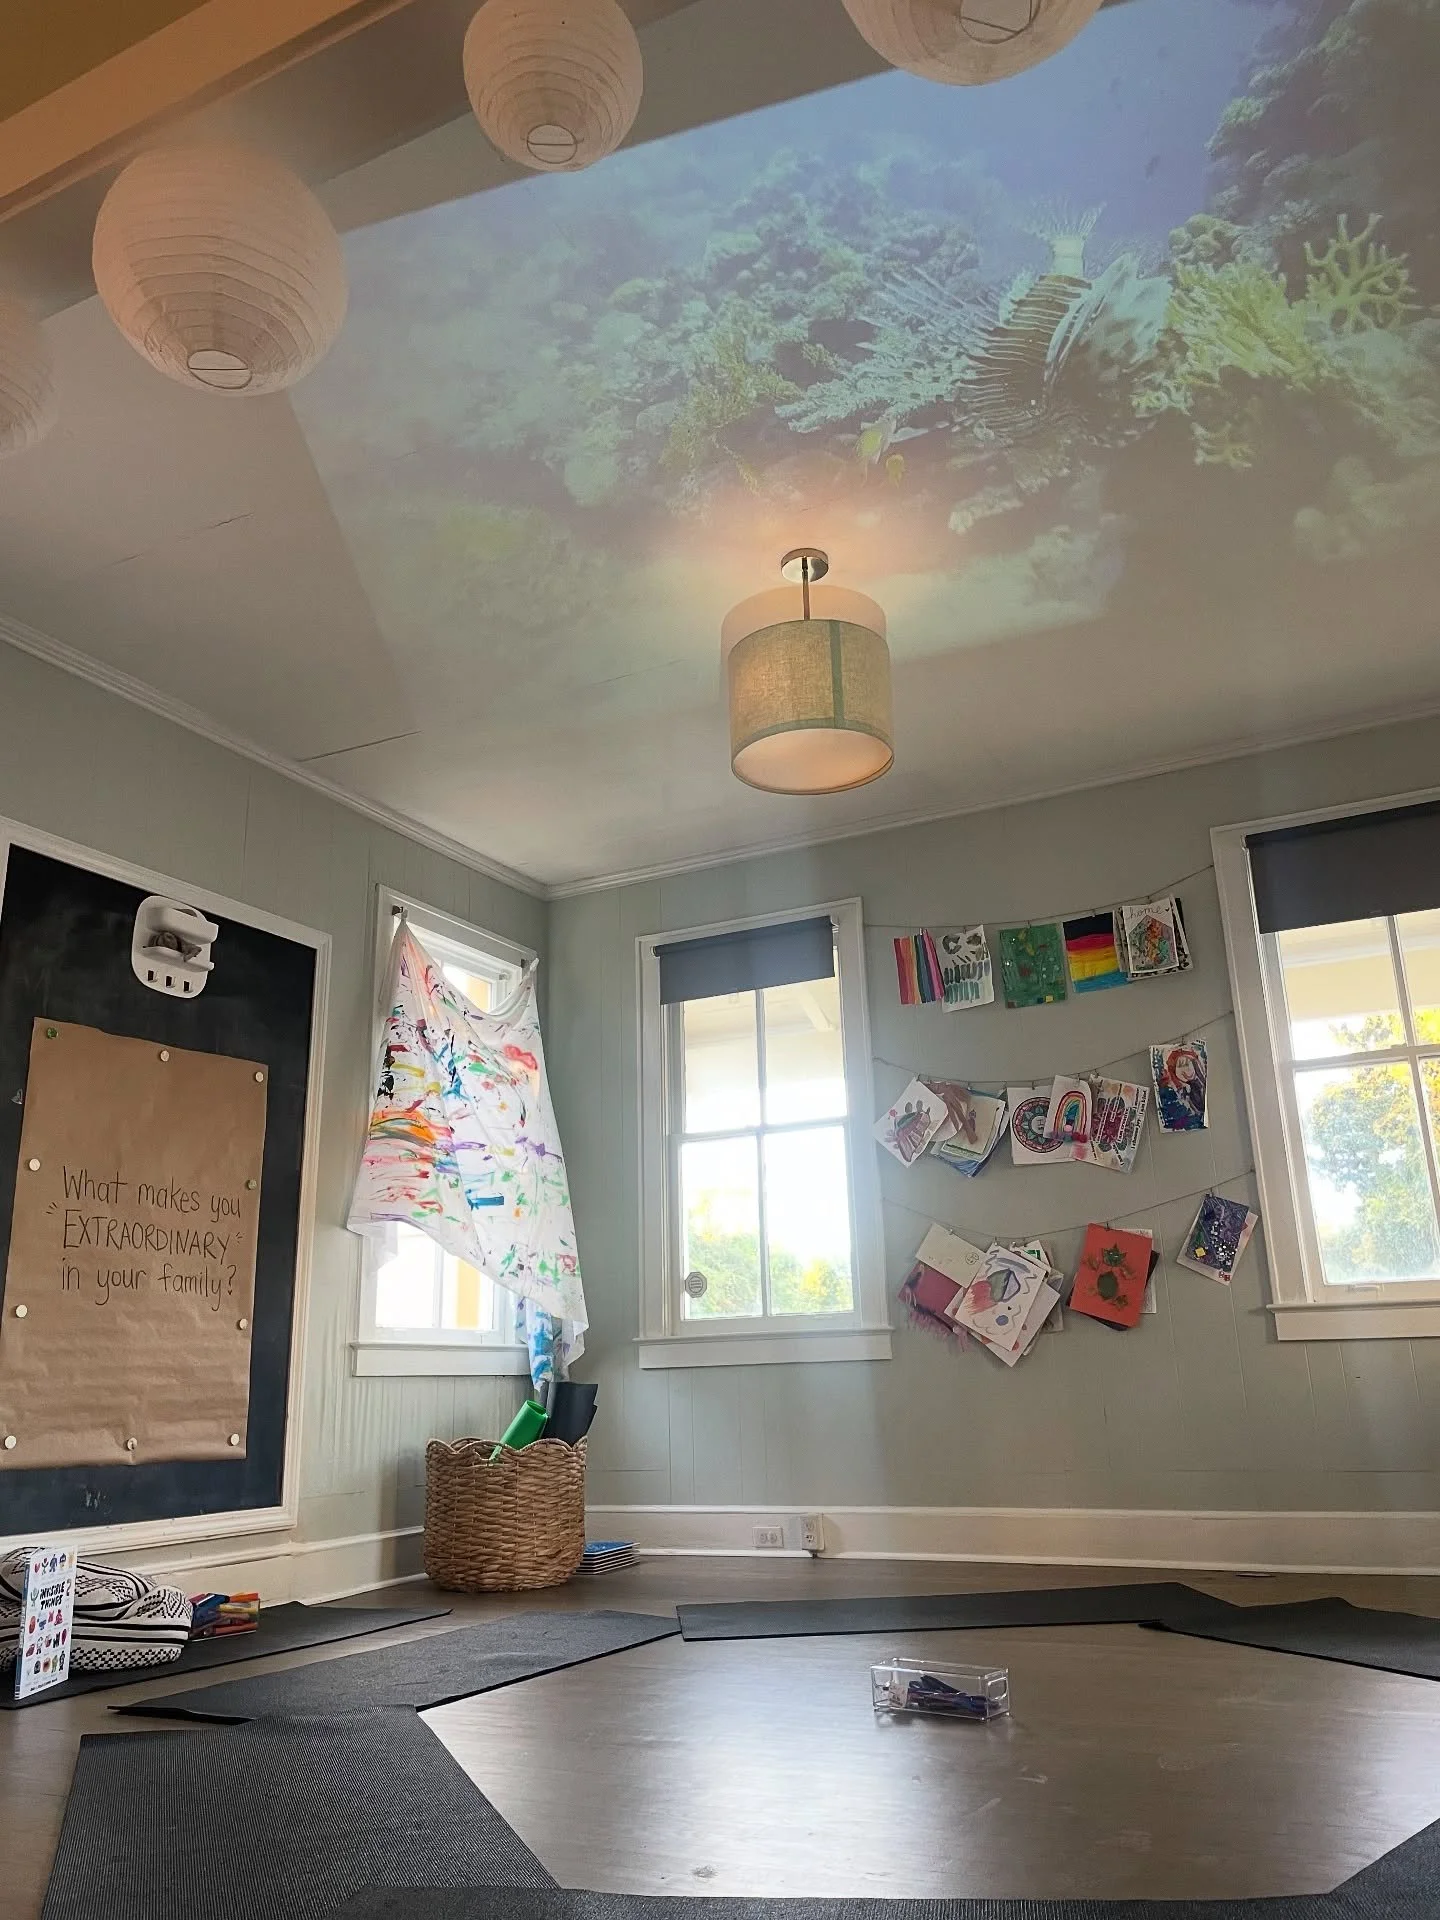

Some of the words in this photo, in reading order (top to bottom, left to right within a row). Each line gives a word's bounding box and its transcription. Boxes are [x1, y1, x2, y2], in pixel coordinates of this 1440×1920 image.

[63, 1166, 128, 1204] What
[138, 1177, 200, 1213] makes
[211, 1194, 241, 1223] you
[63, 1209, 230, 1264] EXTRAORDINARY
[61, 1257, 80, 1290] in
[95, 1266, 147, 1306] your
[157, 1263, 237, 1312] family?
